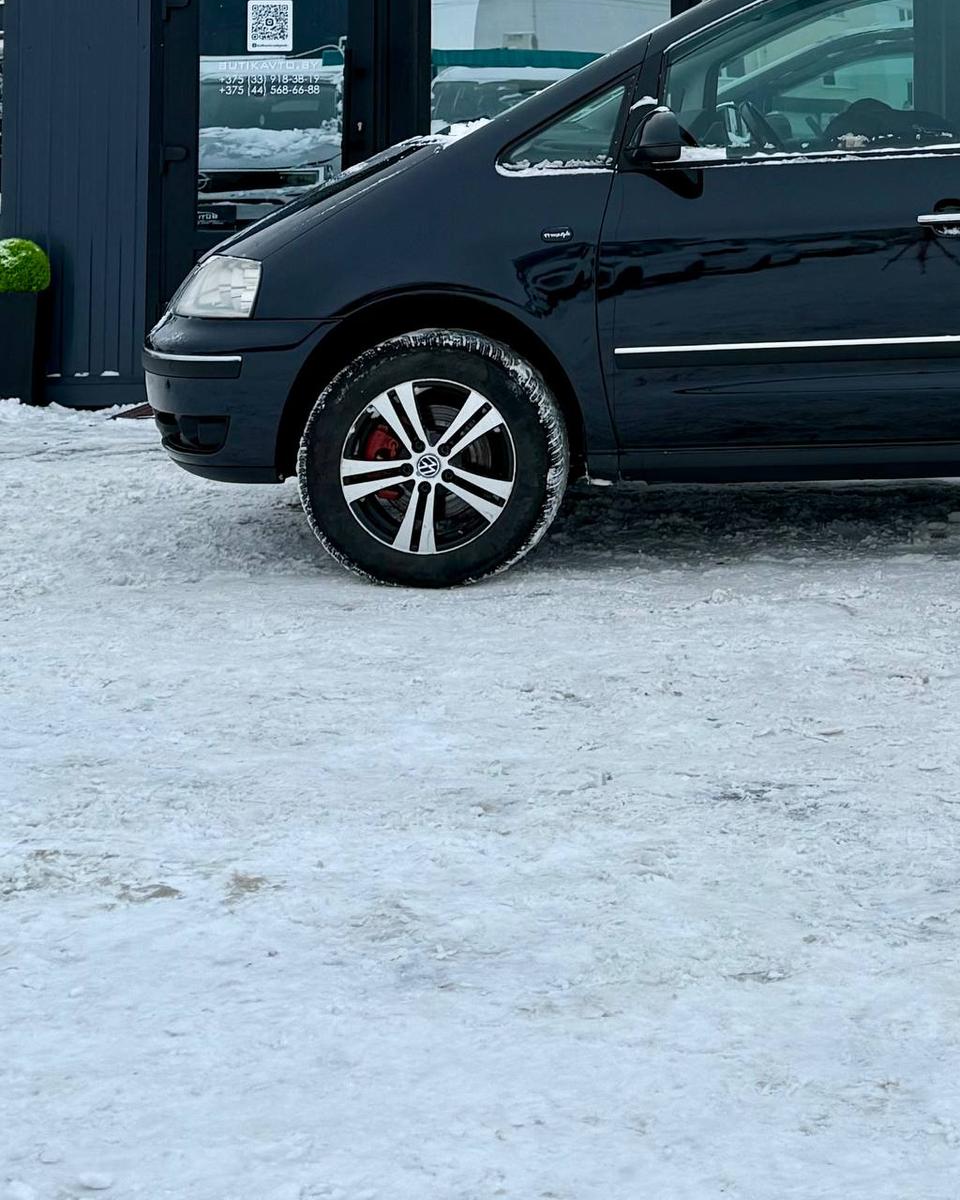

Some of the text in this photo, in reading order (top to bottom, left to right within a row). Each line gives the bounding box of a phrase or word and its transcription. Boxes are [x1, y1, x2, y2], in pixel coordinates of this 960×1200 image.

[219, 84, 320, 97] +375 (44) 568-66-88
